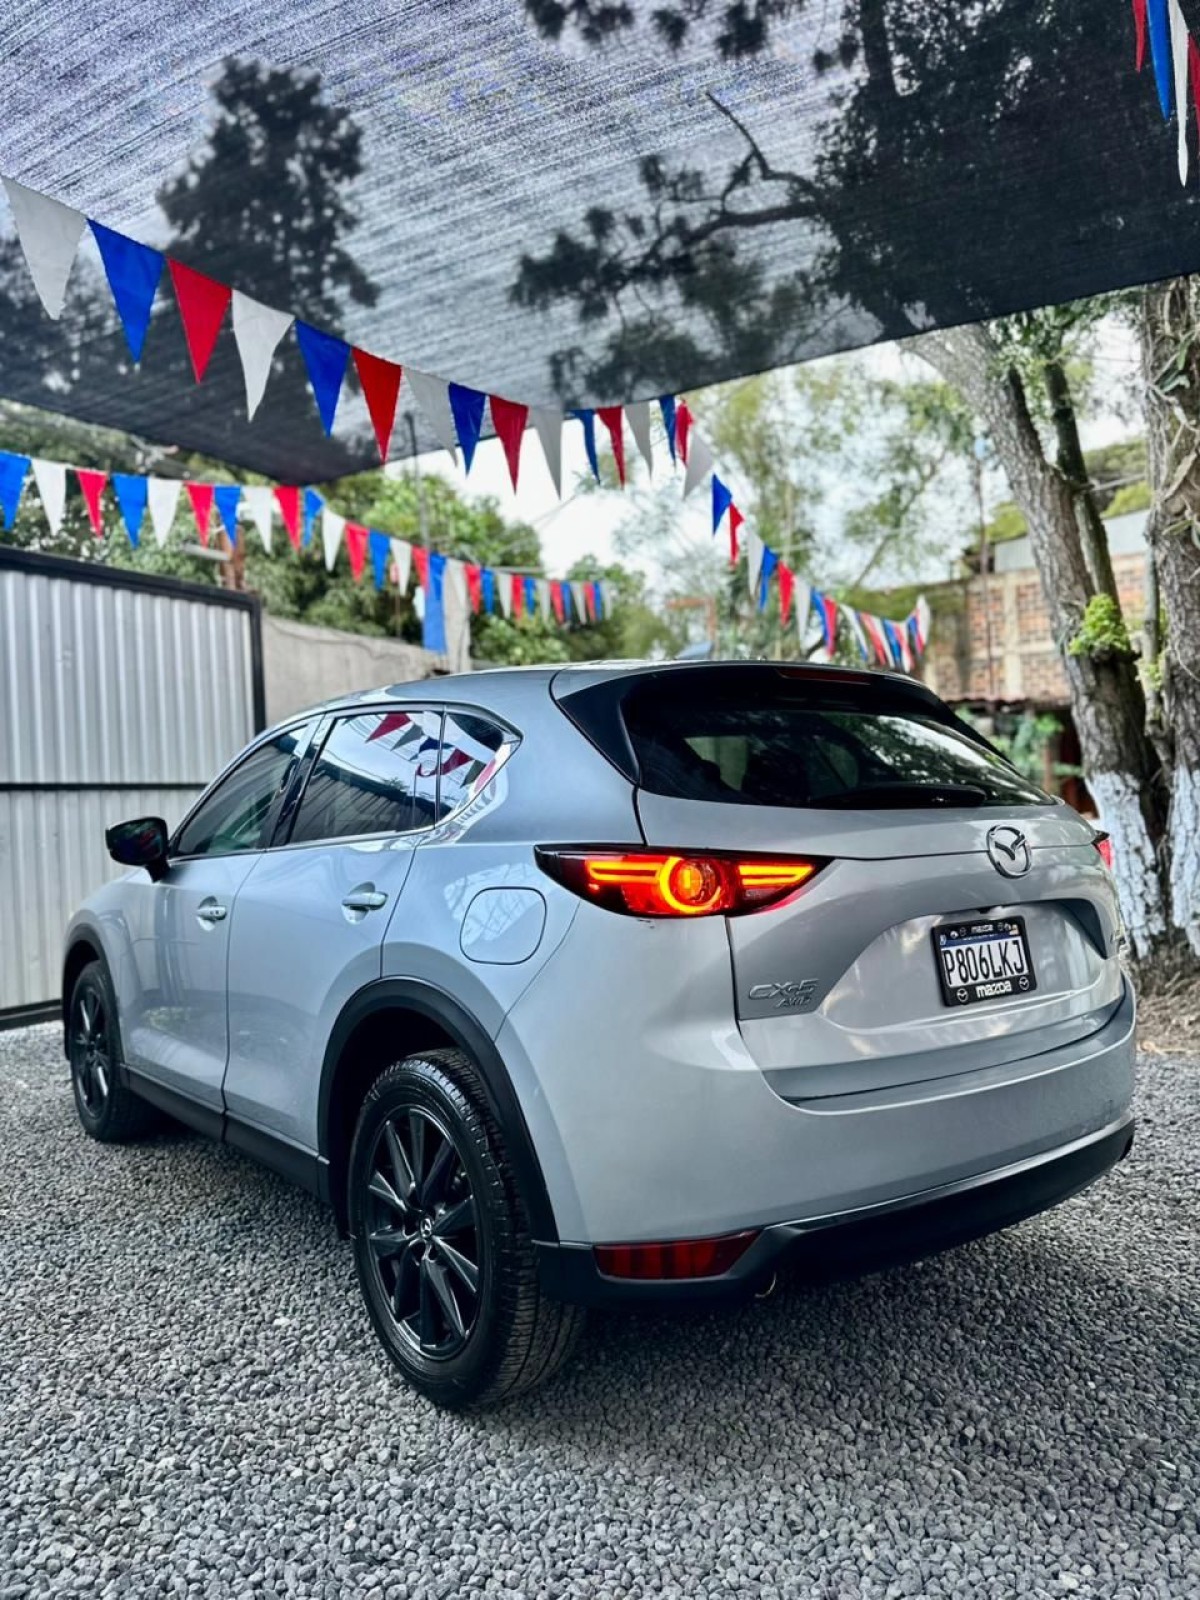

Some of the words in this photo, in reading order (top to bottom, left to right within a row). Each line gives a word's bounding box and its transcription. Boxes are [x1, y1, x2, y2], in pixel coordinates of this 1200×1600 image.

[943, 939, 1025, 986] P806LKJ
[749, 978, 820, 1000] CX-5
[975, 980, 1012, 998] mazda
